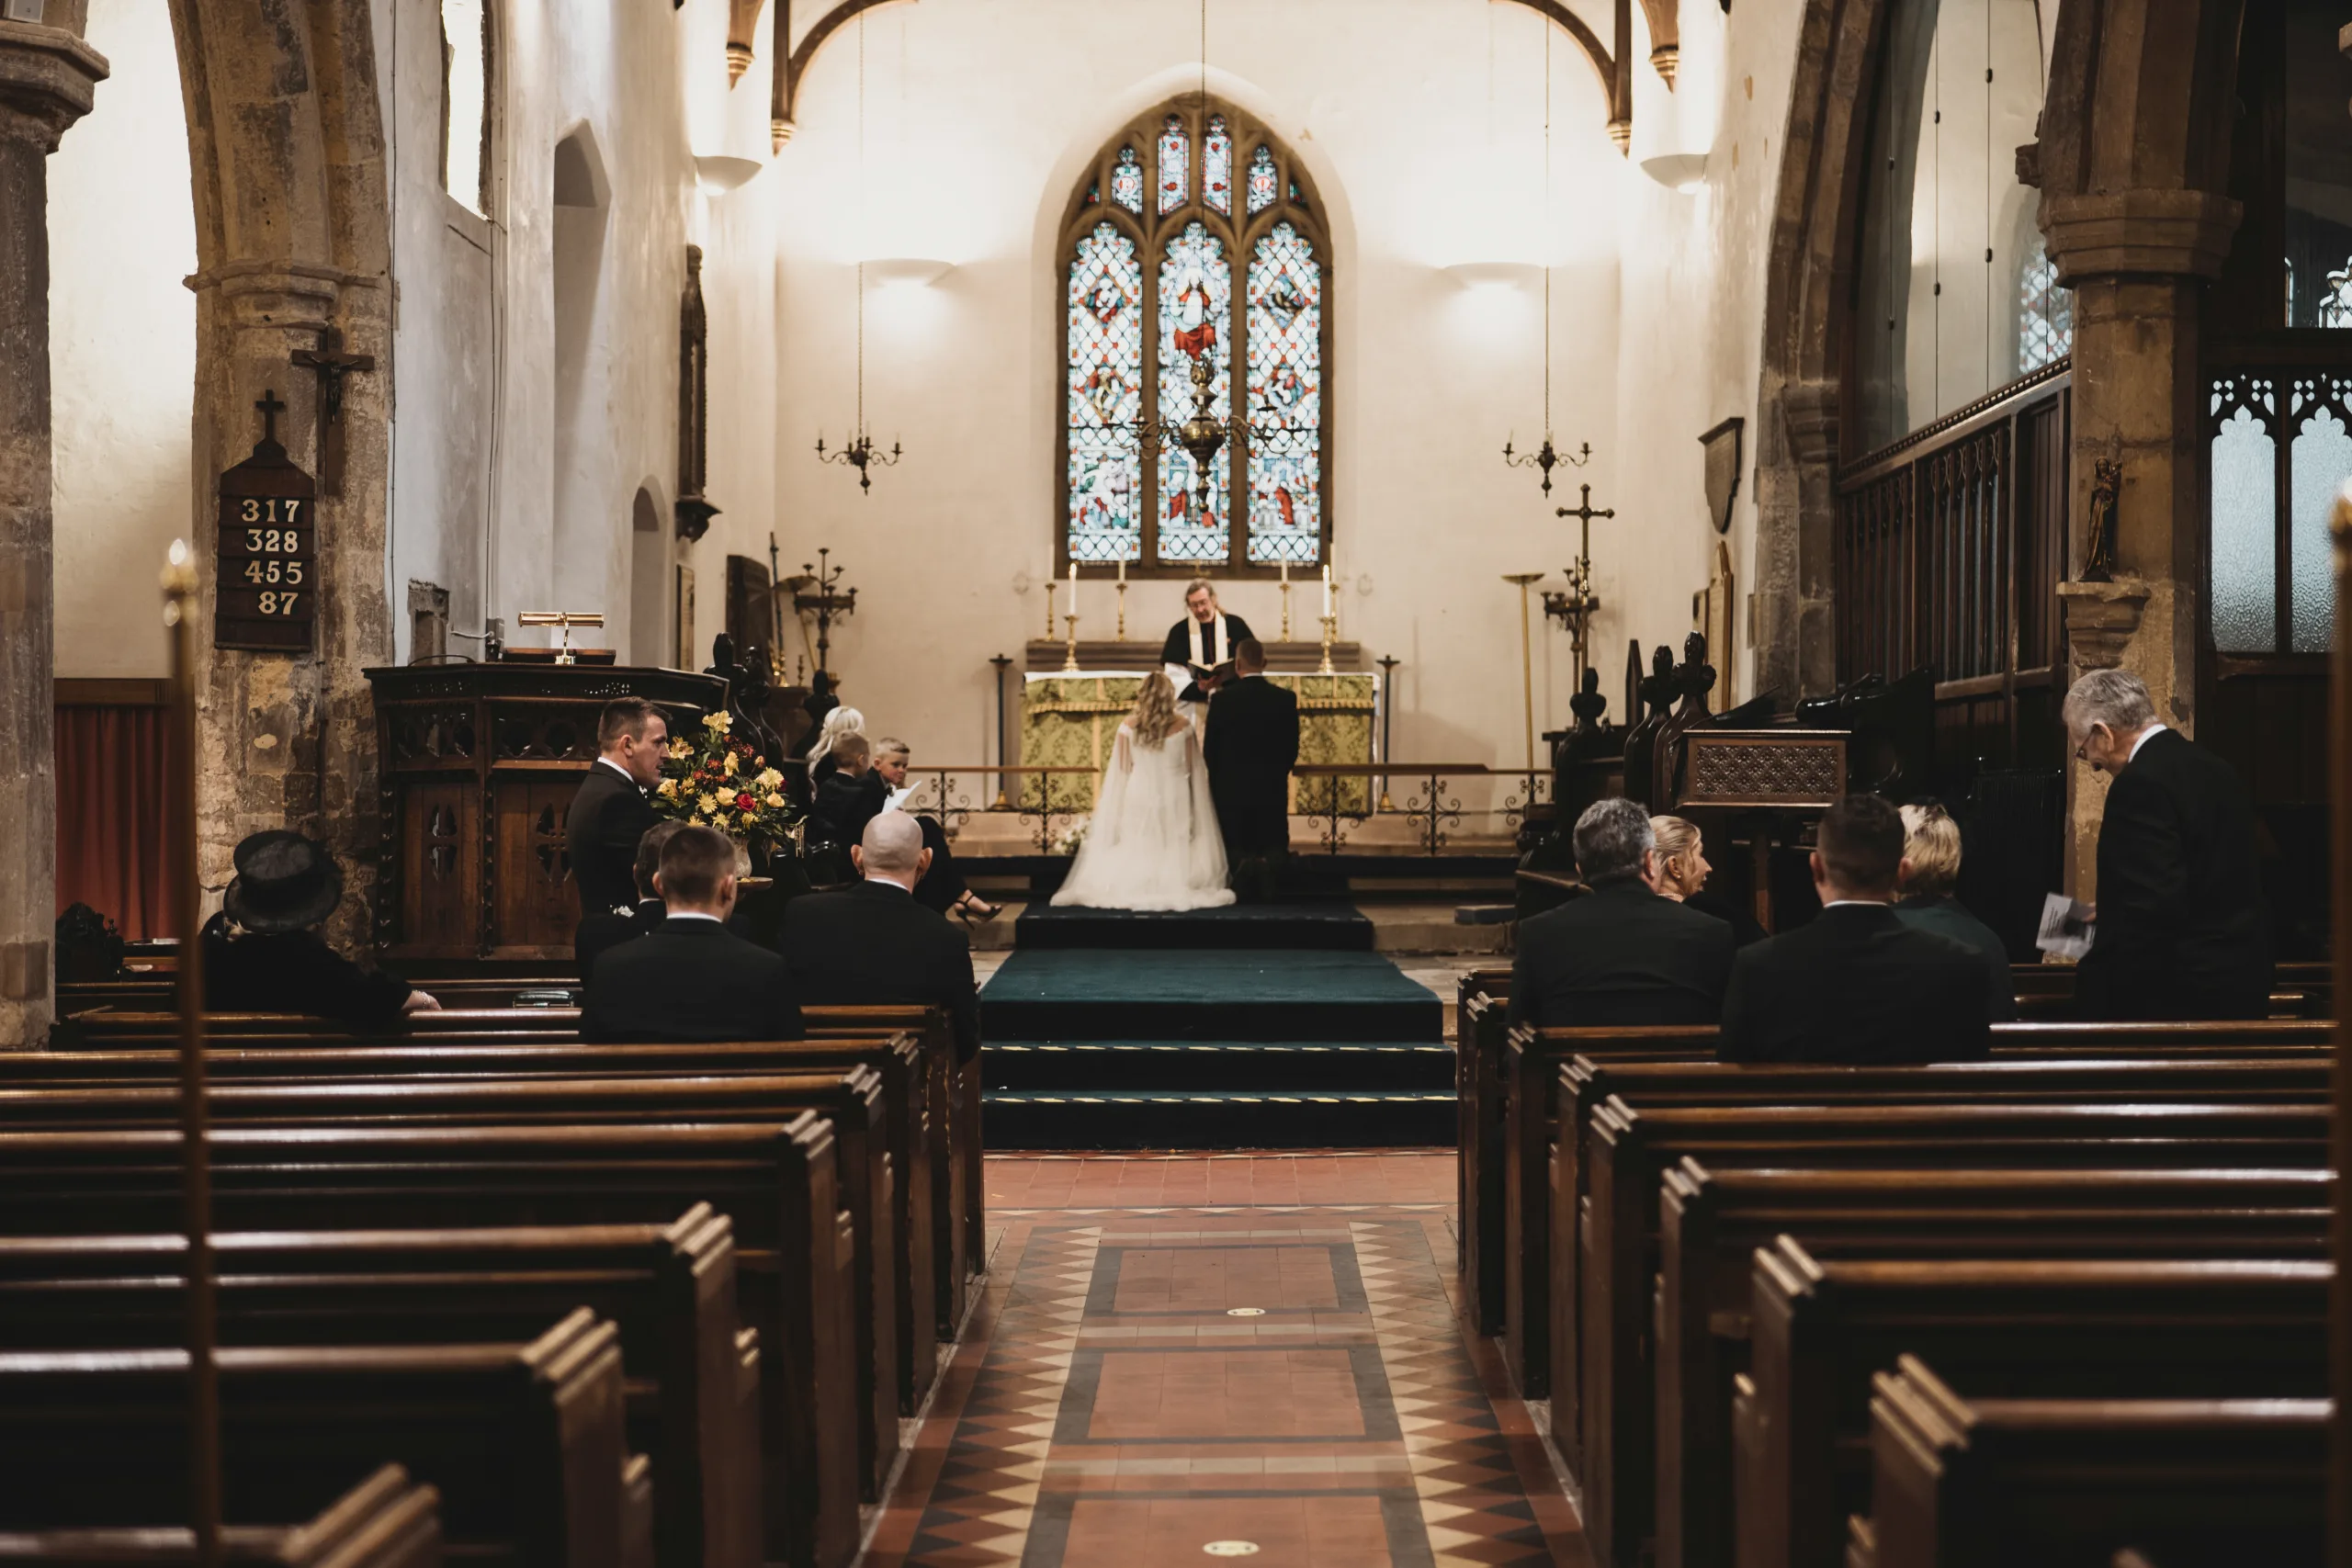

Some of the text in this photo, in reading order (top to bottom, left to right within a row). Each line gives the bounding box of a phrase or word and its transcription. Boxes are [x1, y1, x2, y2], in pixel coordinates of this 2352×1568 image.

[242, 499, 300, 522] 317
[245, 529, 298, 553] 328
[244, 560, 302, 584] 455
[258, 591, 299, 615] 87
